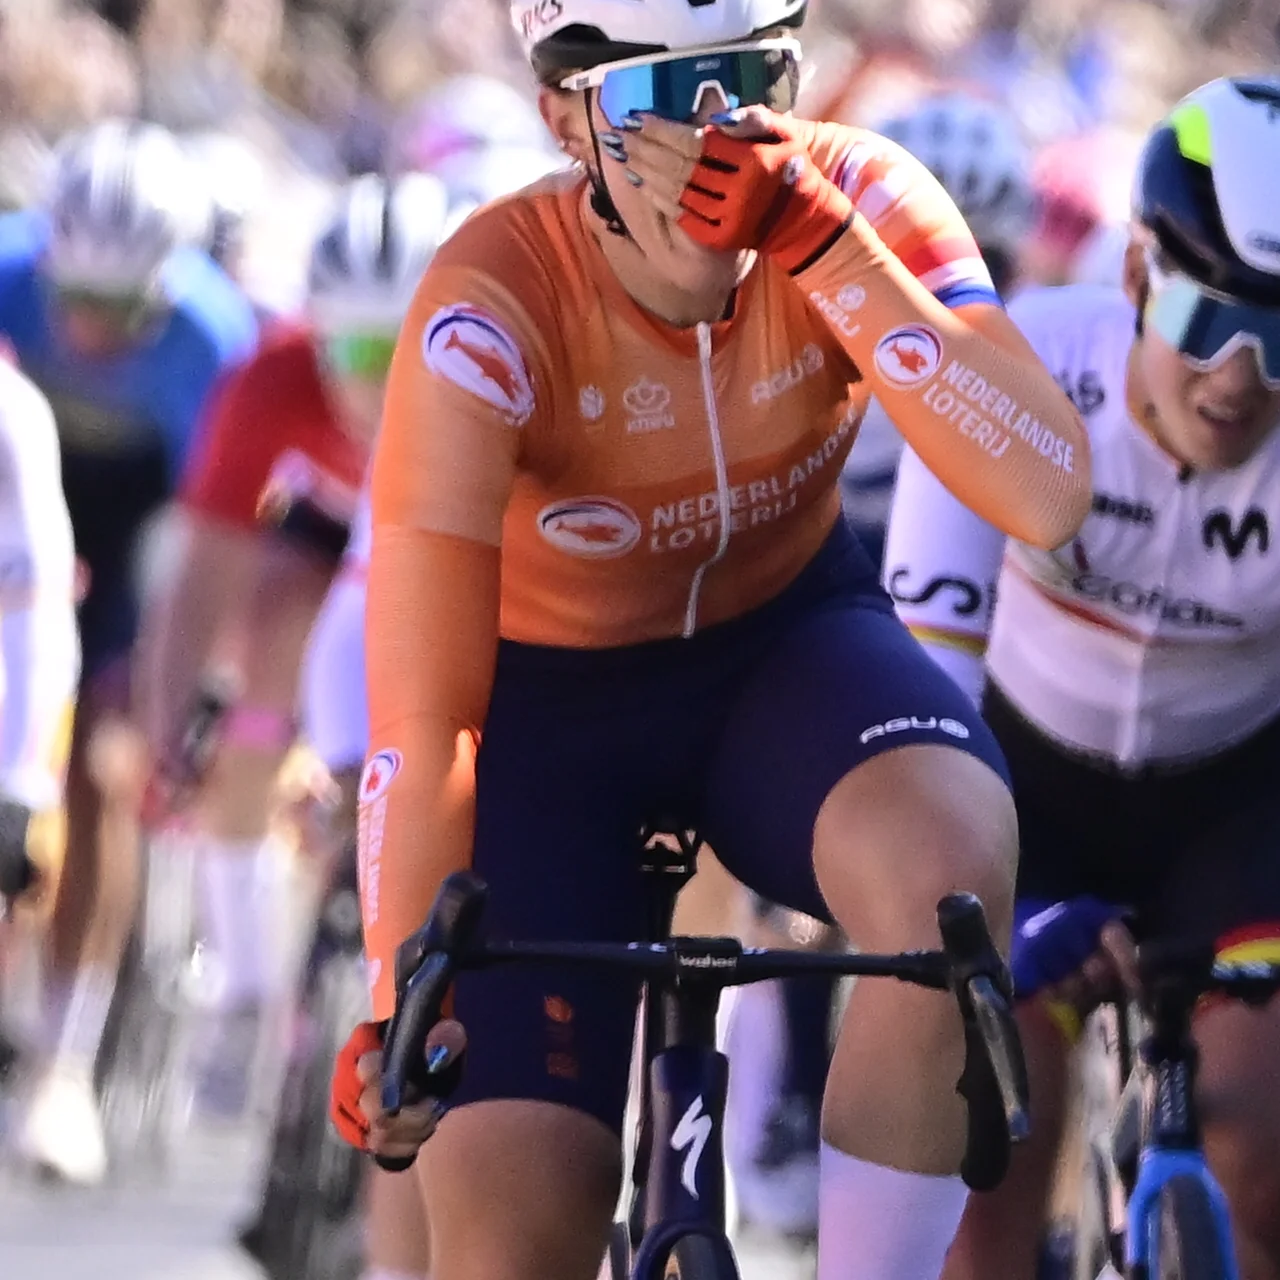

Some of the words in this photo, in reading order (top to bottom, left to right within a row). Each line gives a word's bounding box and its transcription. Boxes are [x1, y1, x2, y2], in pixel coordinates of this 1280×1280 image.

[922, 382, 1013, 458] LOTERIJ
[941, 360, 1075, 473] NEDERLANDSE
[650, 490, 798, 553] LOTERIJ
[860, 716, 937, 744] AGU
